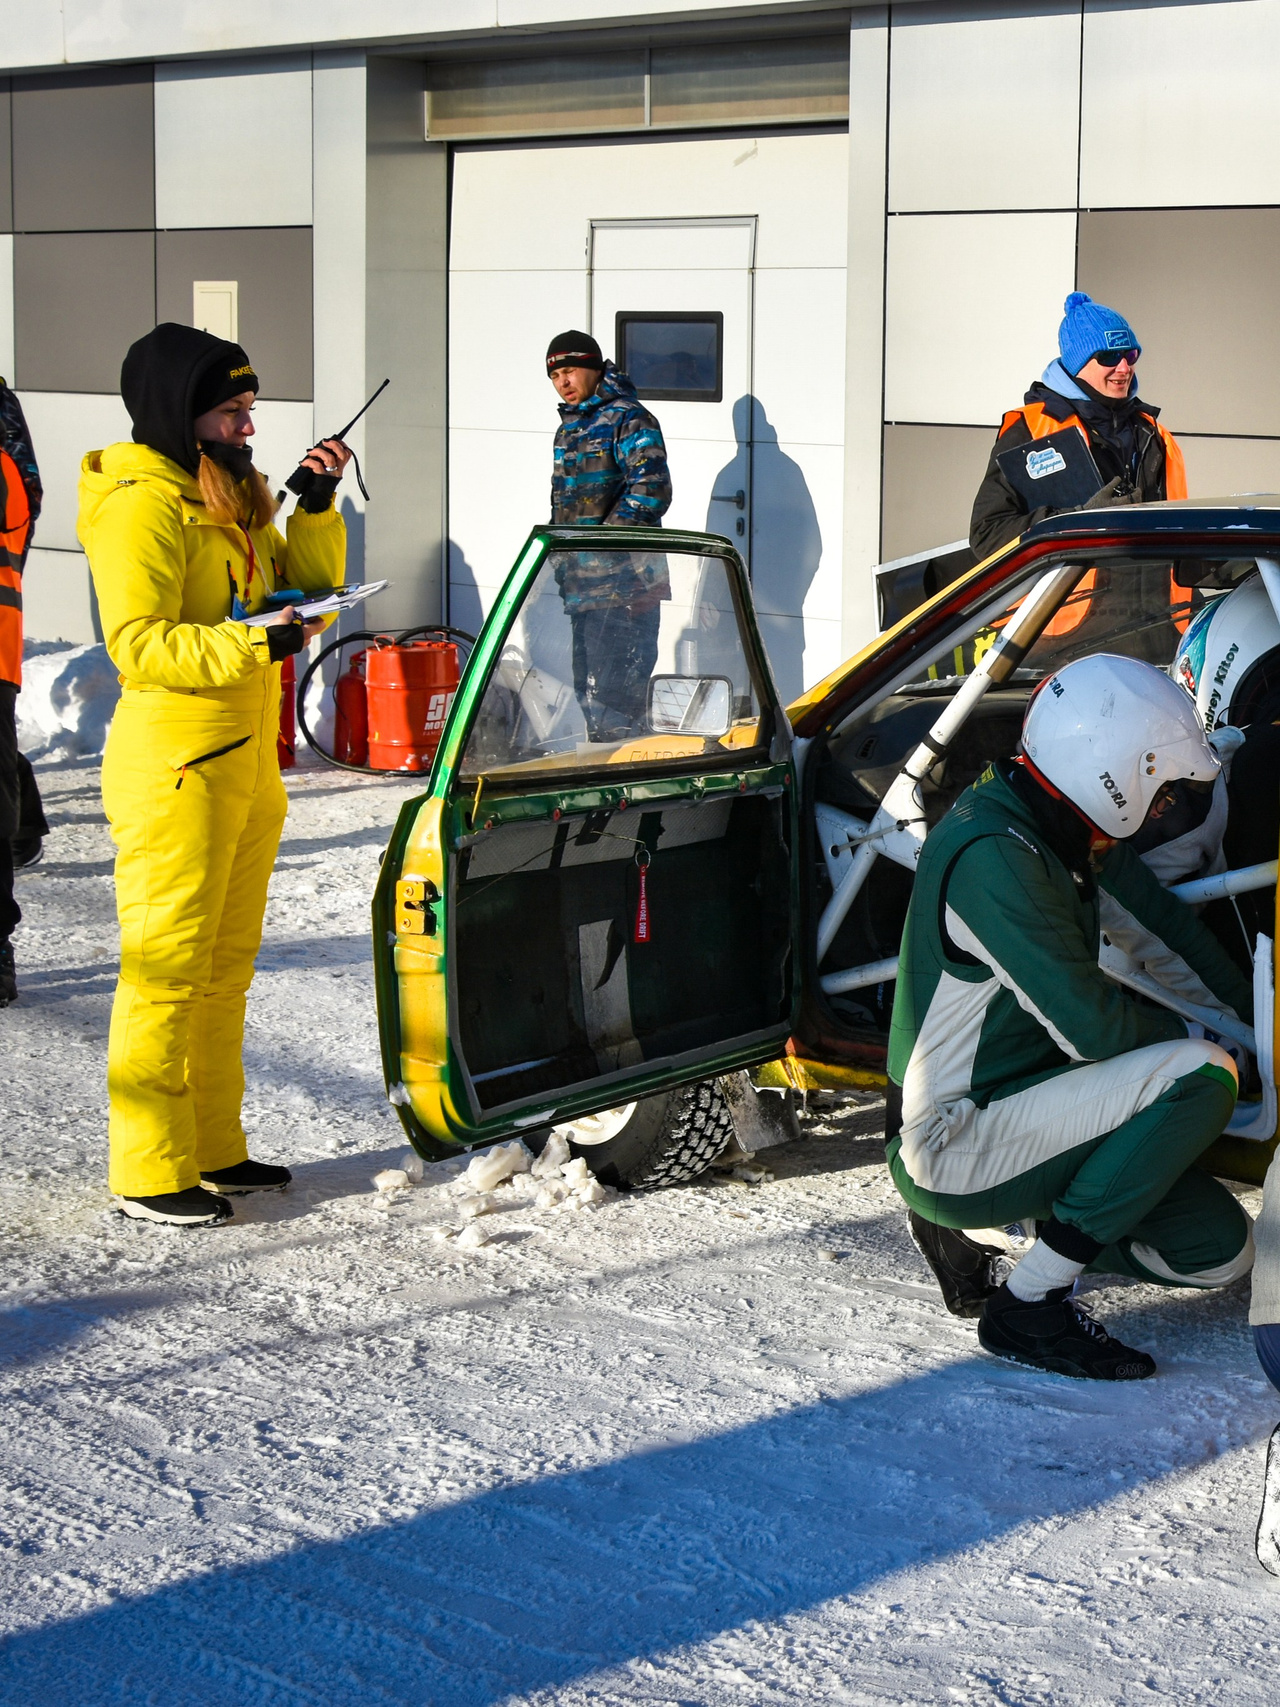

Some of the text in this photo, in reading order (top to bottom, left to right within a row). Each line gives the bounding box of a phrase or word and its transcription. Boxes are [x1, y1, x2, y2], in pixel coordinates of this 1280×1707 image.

[1204, 642, 1240, 734] ndrey Kitov
[1099, 771, 1128, 809] TOORA
[638, 922, 647, 938] DRIFT
[1115, 1363, 1147, 1377] OMP
